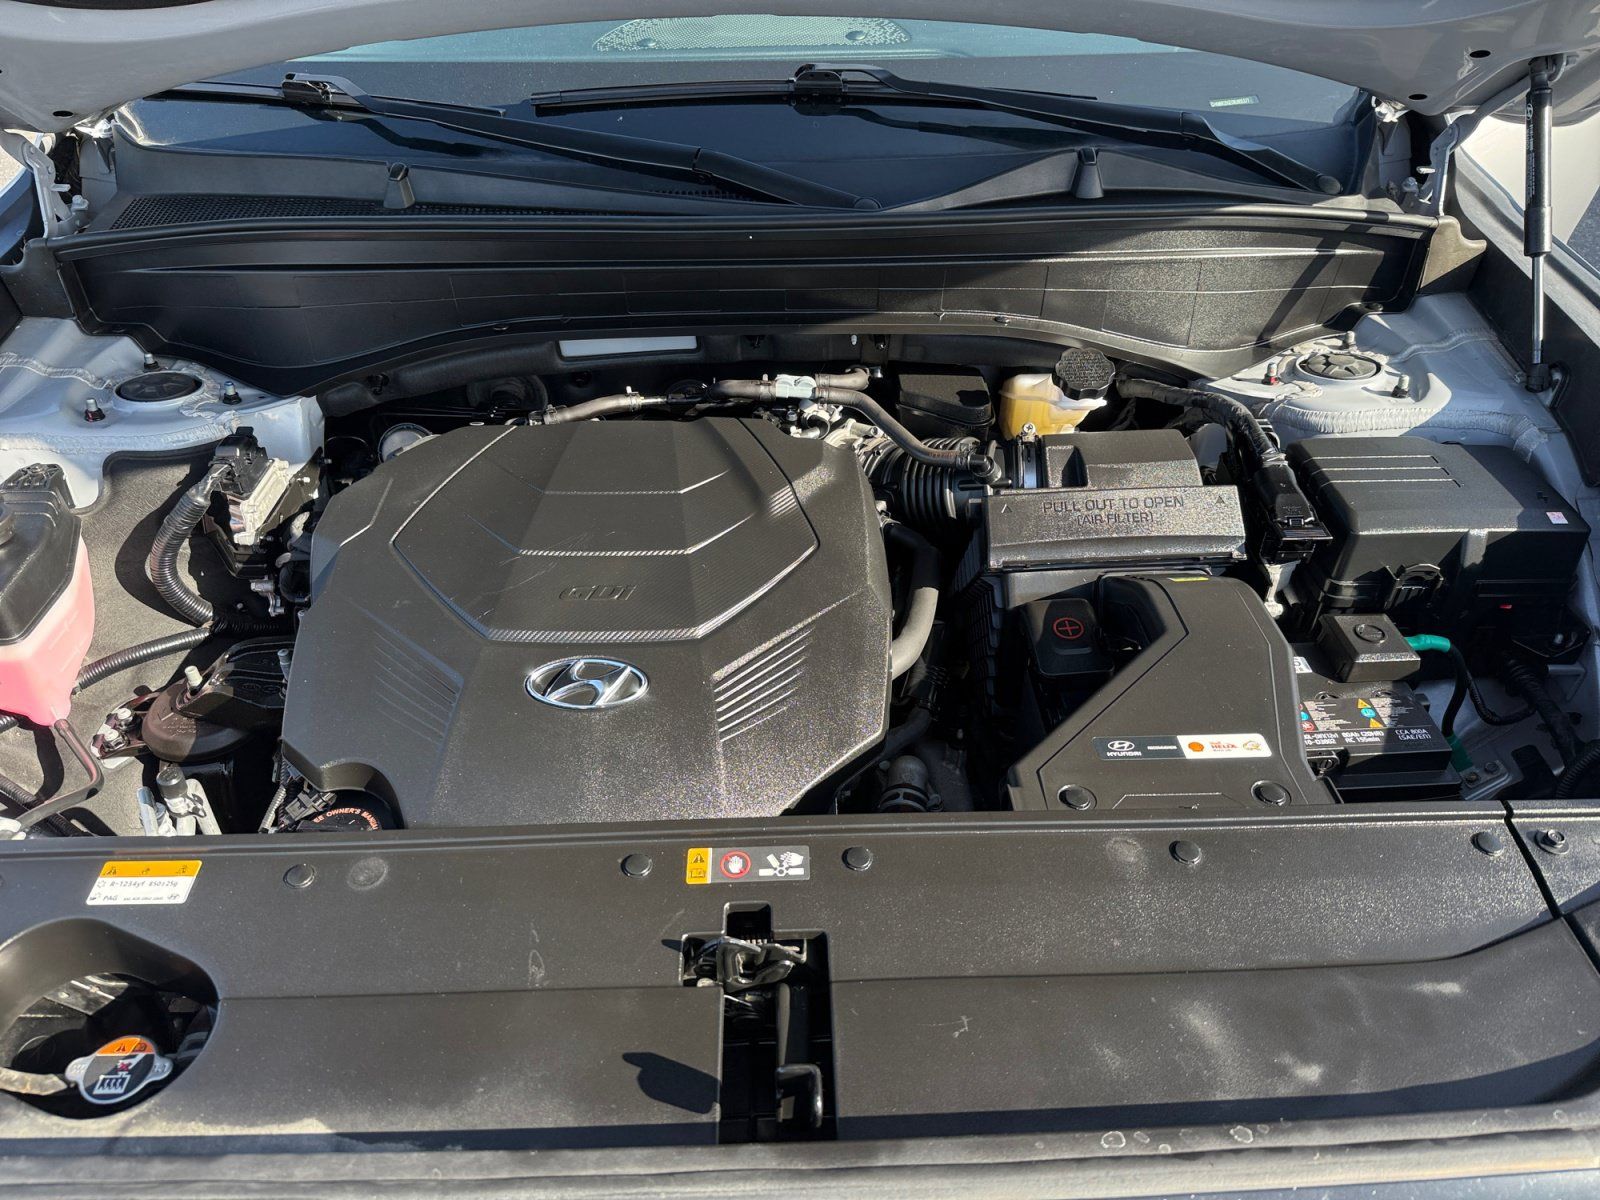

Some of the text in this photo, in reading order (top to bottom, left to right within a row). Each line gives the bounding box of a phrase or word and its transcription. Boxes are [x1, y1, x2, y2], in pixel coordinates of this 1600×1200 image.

[1043, 495, 1184, 514] PULL OUT TO OPEN
[326, 807, 362, 817] OWNER'S
